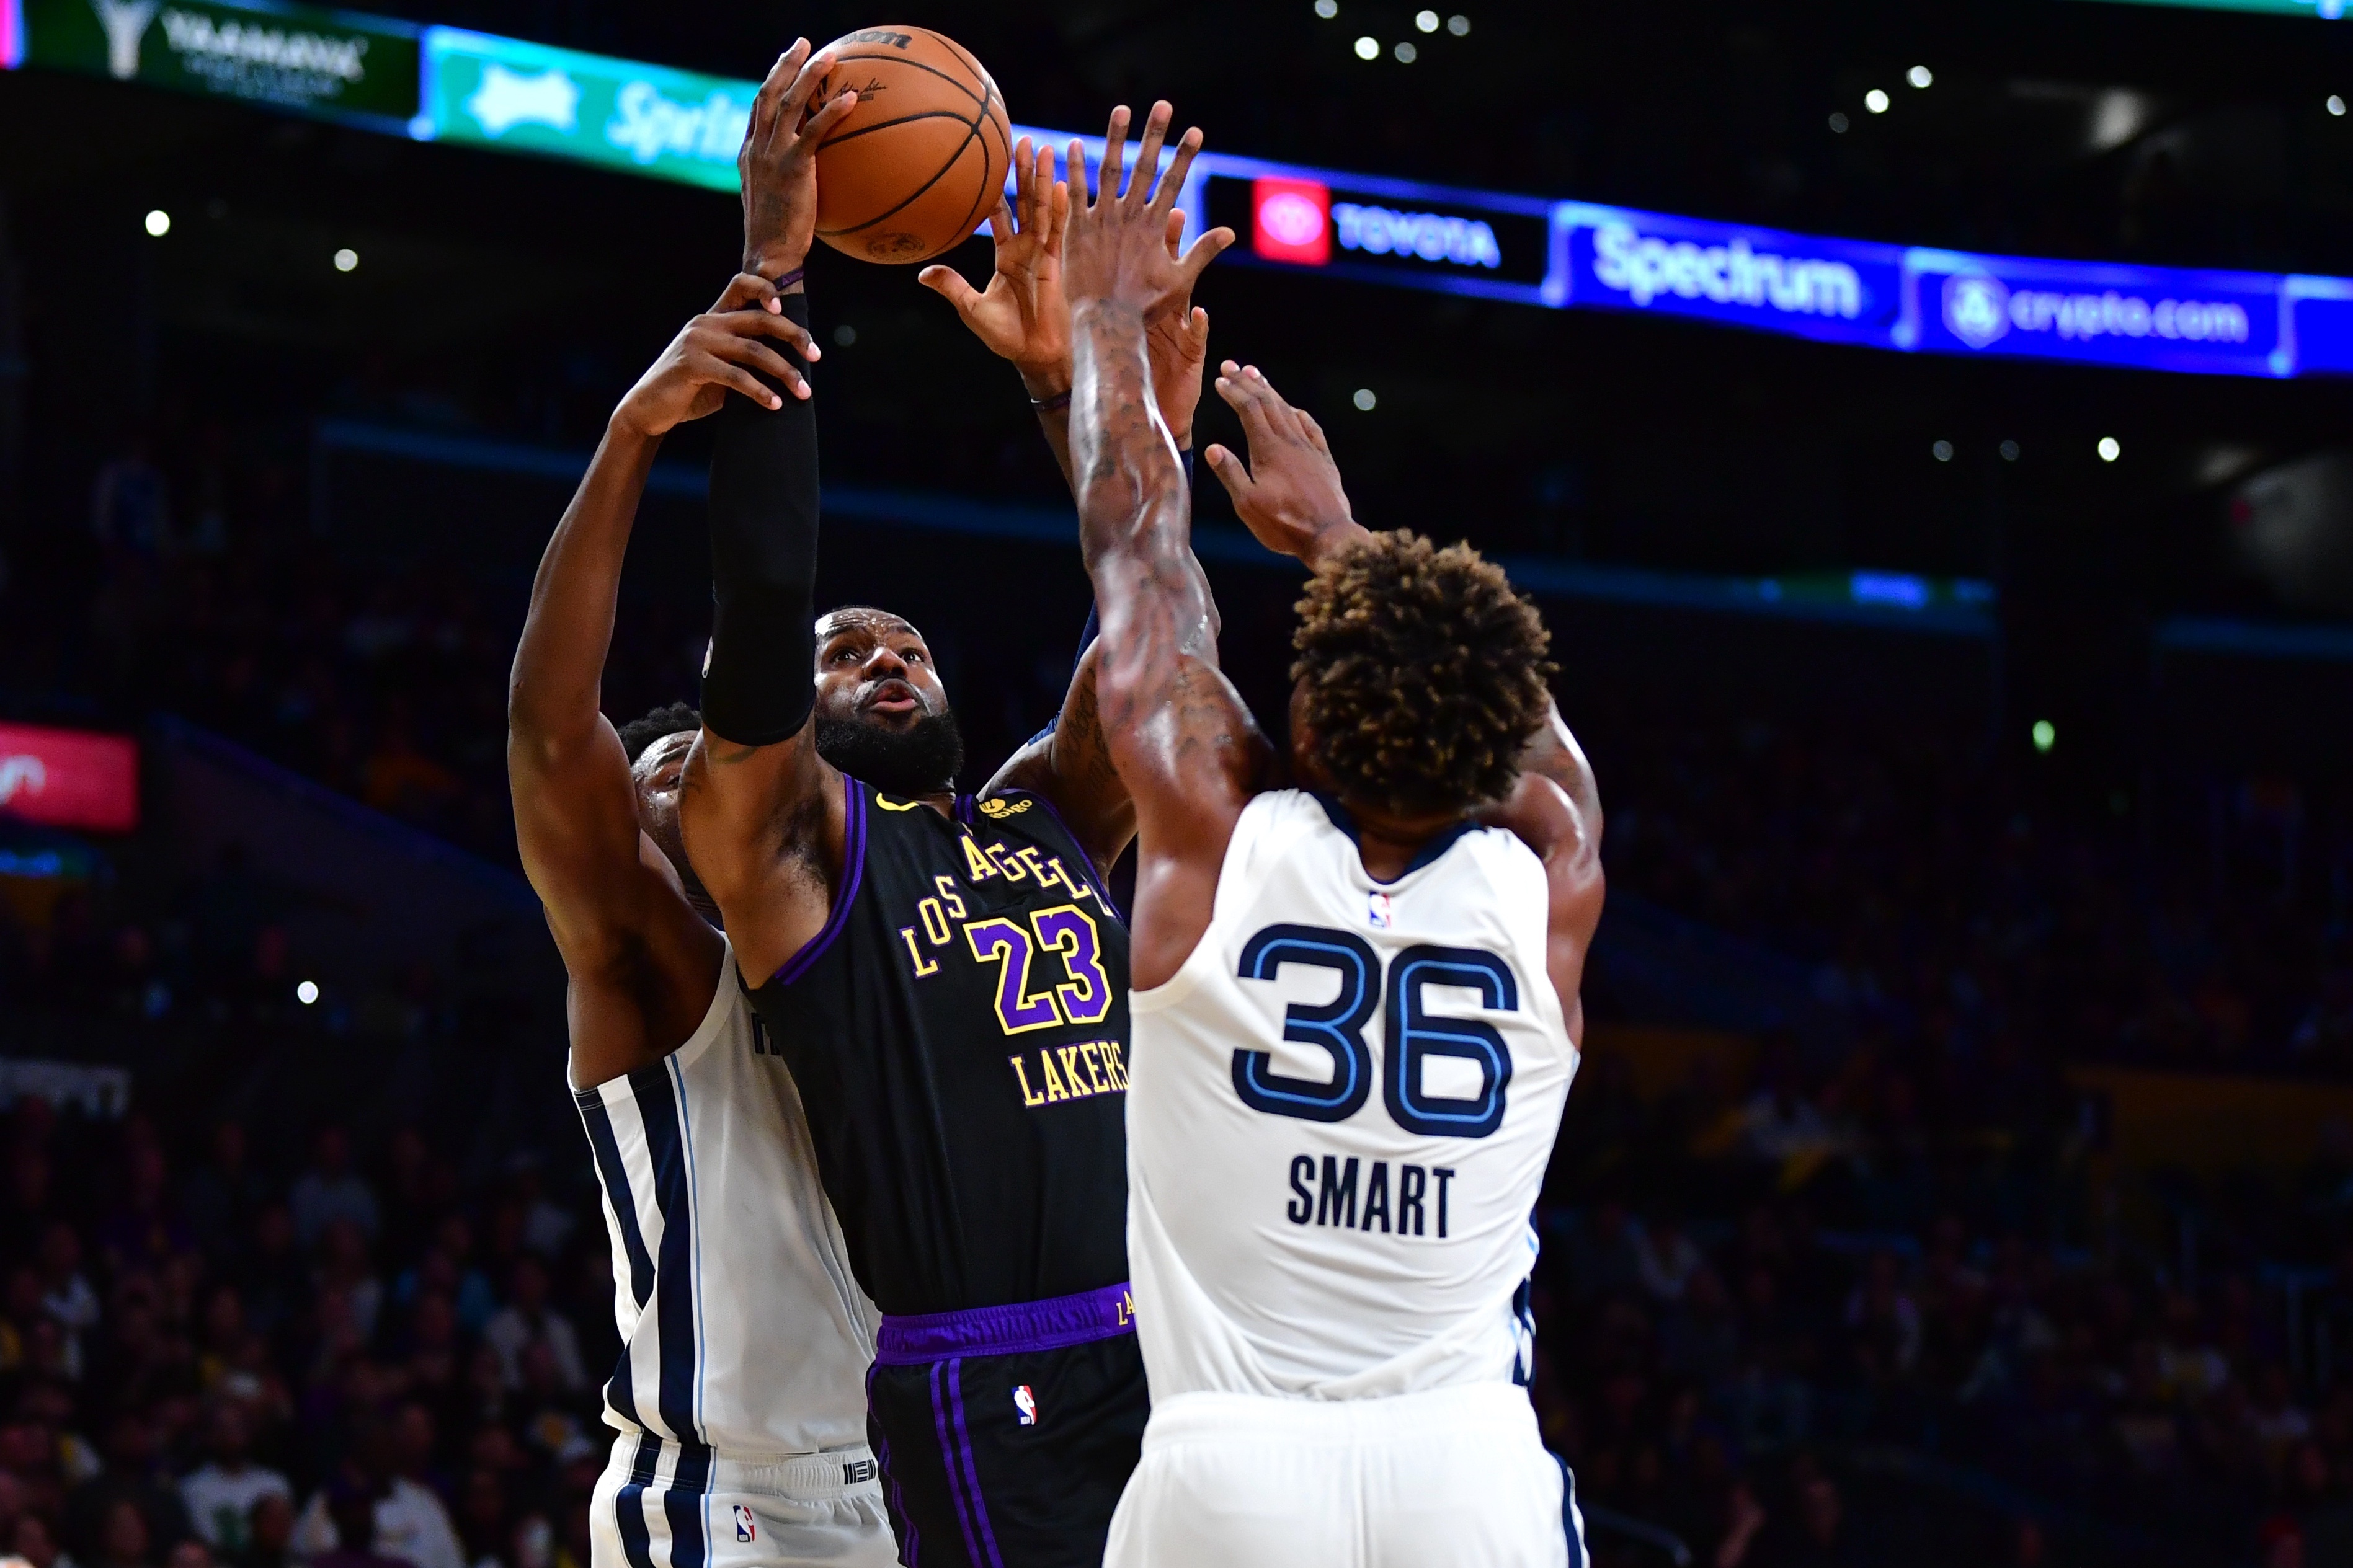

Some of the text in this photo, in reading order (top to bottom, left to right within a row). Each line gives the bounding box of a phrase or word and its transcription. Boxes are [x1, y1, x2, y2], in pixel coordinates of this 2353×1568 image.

[1332, 202, 1500, 268] TOYOTA
[1592, 220, 1861, 320] Spectrum
[2008, 290, 2249, 343] crypto.com
[900, 875, 967, 978] LOS
[963, 904, 1113, 1035] 23
[1010, 1041, 1129, 1106] LAKERS
[1232, 921, 1518, 1138] 36
[1288, 1154, 1455, 1238] SMART
